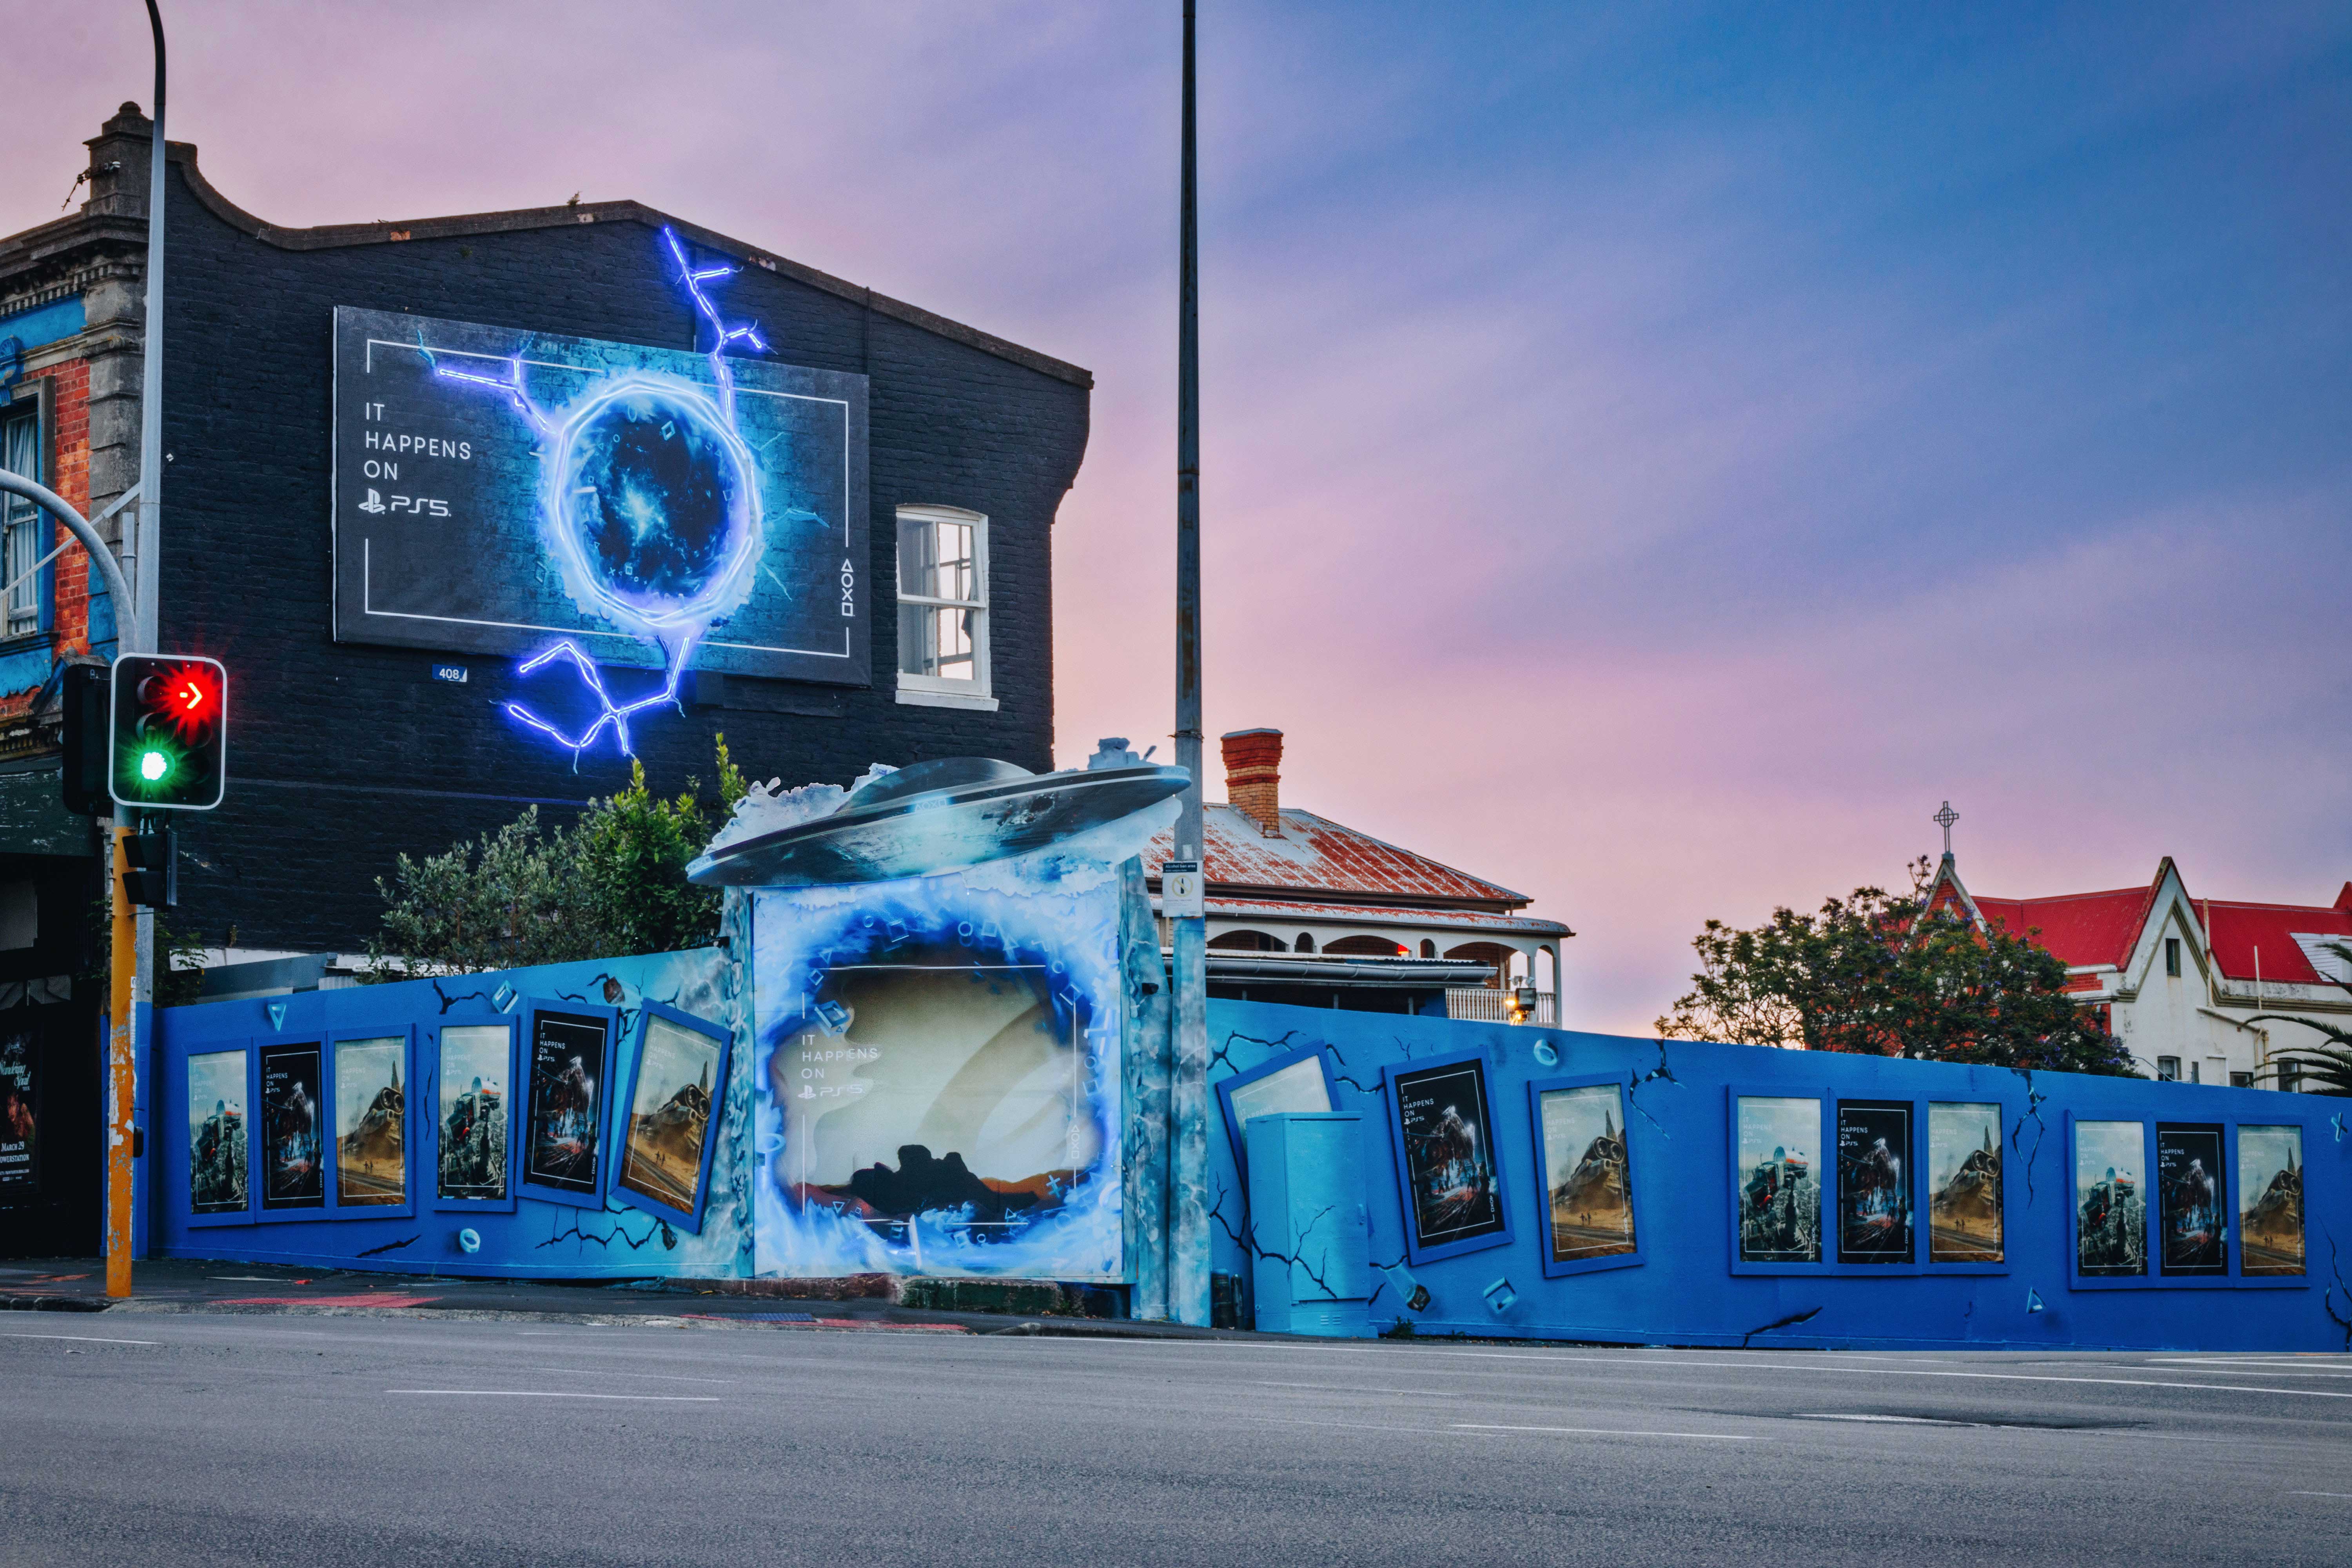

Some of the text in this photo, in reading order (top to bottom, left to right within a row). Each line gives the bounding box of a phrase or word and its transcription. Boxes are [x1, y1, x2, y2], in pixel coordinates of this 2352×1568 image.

[366, 402, 385, 421] IT
[366, 431, 471, 460] HAPPENS
[364, 460, 397, 480] ON
[390, 495, 449, 517] PS5
[439, 668, 459, 679] 408
[540, 1040, 565, 1049] HAPPENS
[802, 1034, 815, 1045] IT
[802, 1048, 878, 1062] HAPPENS
[801, 1068, 824, 1079] ON
[820, 1084, 863, 1097] PS5
[1404, 1098, 1434, 1110] HAPPENS
[18, 1141, 24, 1150] 29
[0, 1154, 29, 1163] OWERSTATION
